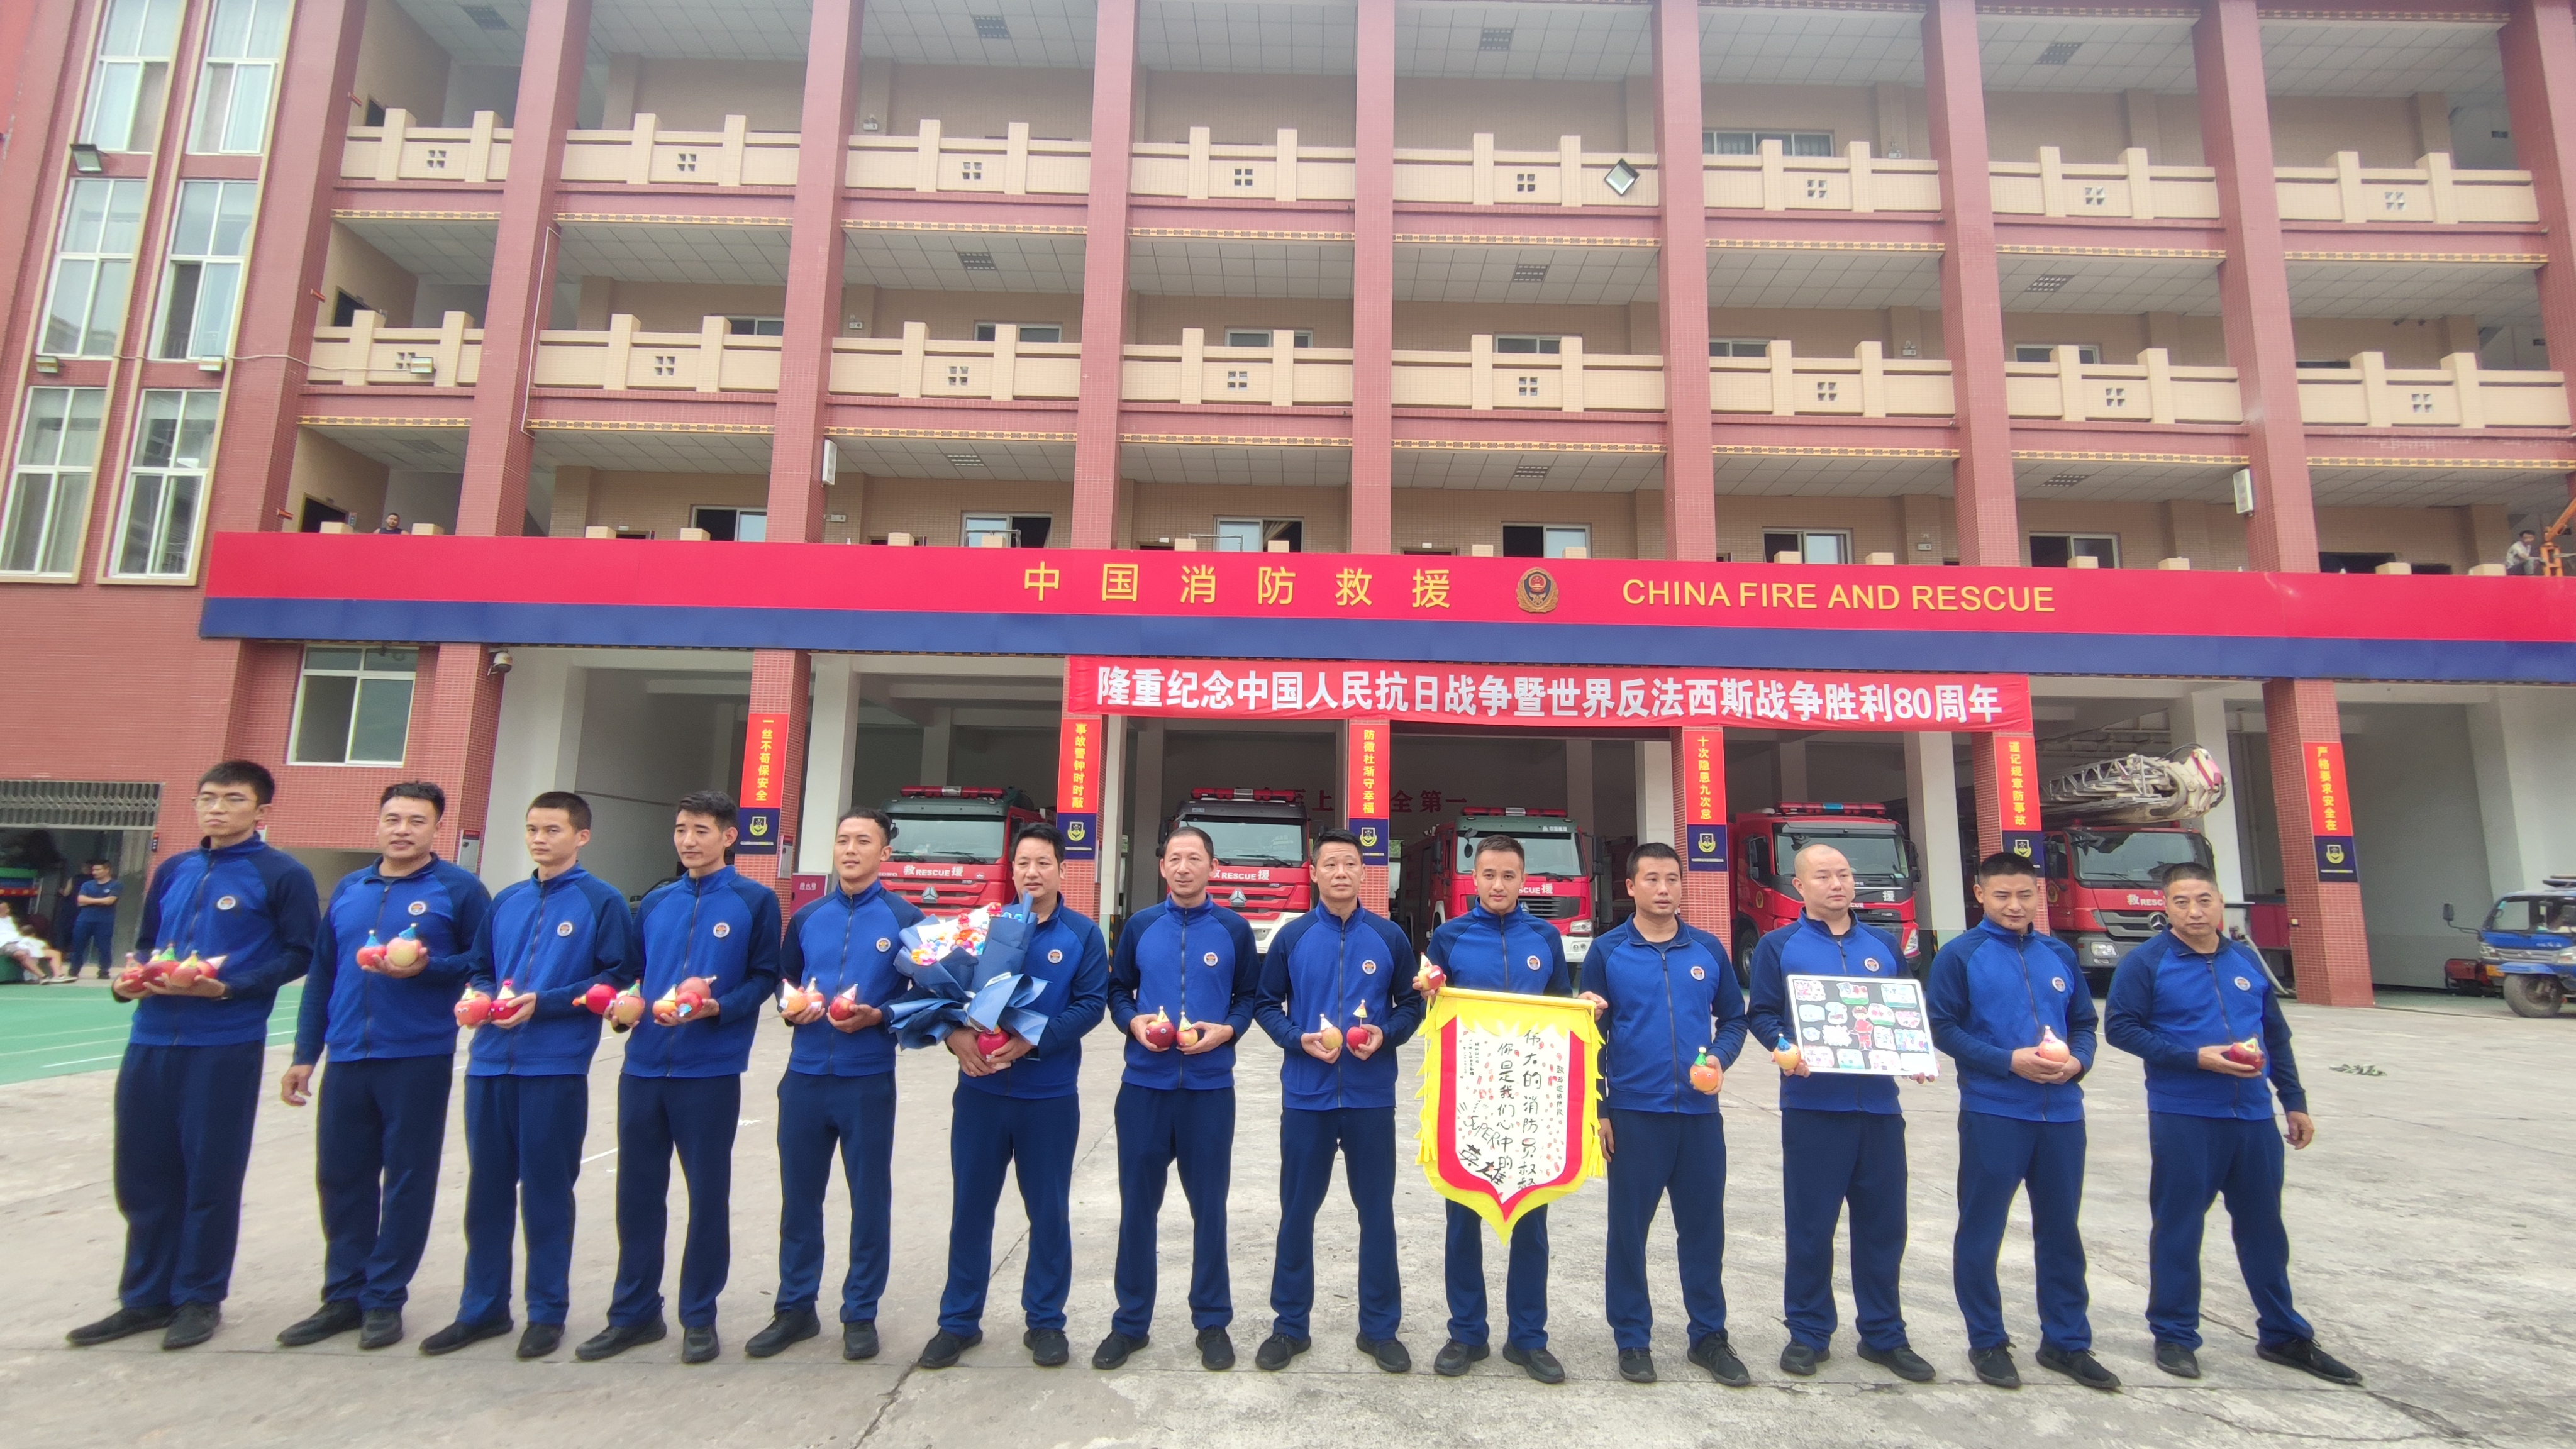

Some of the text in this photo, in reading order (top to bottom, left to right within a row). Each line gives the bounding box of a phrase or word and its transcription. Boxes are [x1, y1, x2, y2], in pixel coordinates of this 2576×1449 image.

[1024, 560, 1450, 609] 中国消防救援
[1623, 579, 2055, 613] CHINA FIRE AND RESCUE
[1097, 665, 2003, 724] 隆重纪念中国人民抗日战争暨世界反法西斯战争胜利80周年
[755, 719, 774, 801] 一丝不苟保安全
[1071, 723, 1087, 809] 事故警钟时时敲
[1362, 729, 1375, 814] 防微杜渐守幸福
[2009, 741, 2027, 826] 谨记规章防事故
[2317, 746, 2338, 831] 严格要求安全在
[1221, 872, 1257, 880] RESCUE
